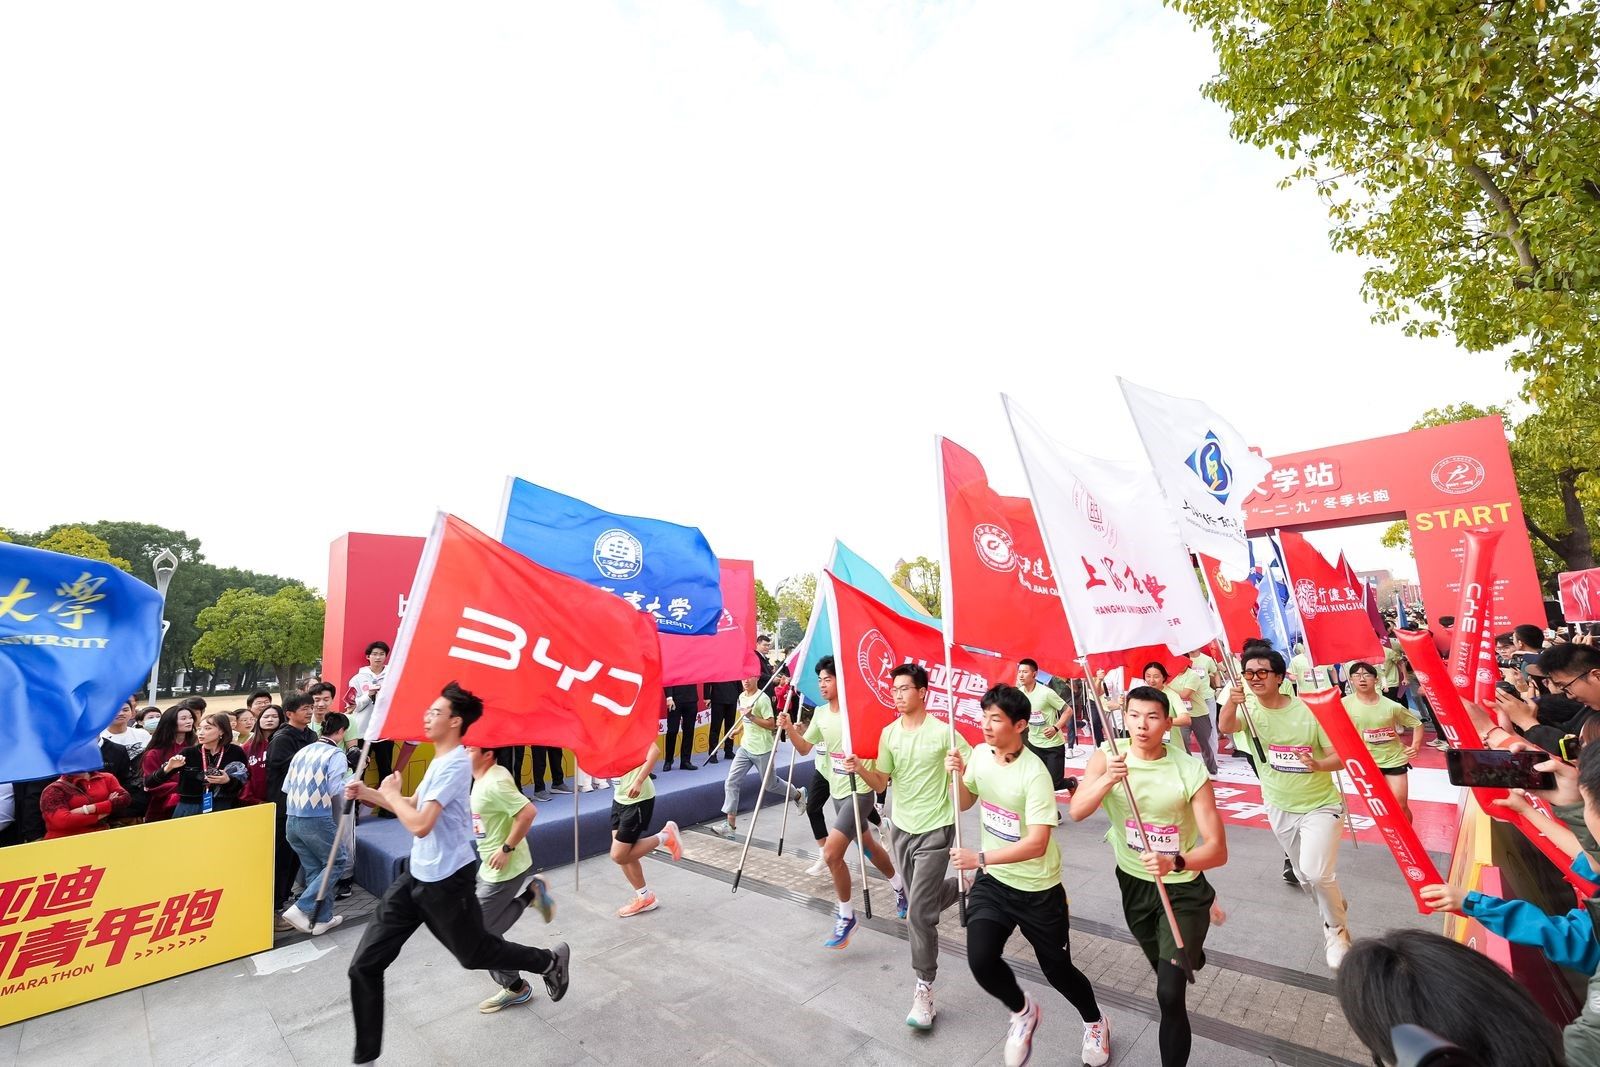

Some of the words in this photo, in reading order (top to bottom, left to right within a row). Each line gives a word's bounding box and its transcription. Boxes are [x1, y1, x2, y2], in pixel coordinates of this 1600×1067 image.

[1415, 502, 1512, 531] START
[1461, 583, 1482, 633] BYD
[448, 607, 643, 716] BYD
[923, 689, 985, 722] 国青
[1345, 758, 1389, 816] BYD
[0, 889, 224, 981] 青年跑
[0, 963, 94, 997] MARATHON
